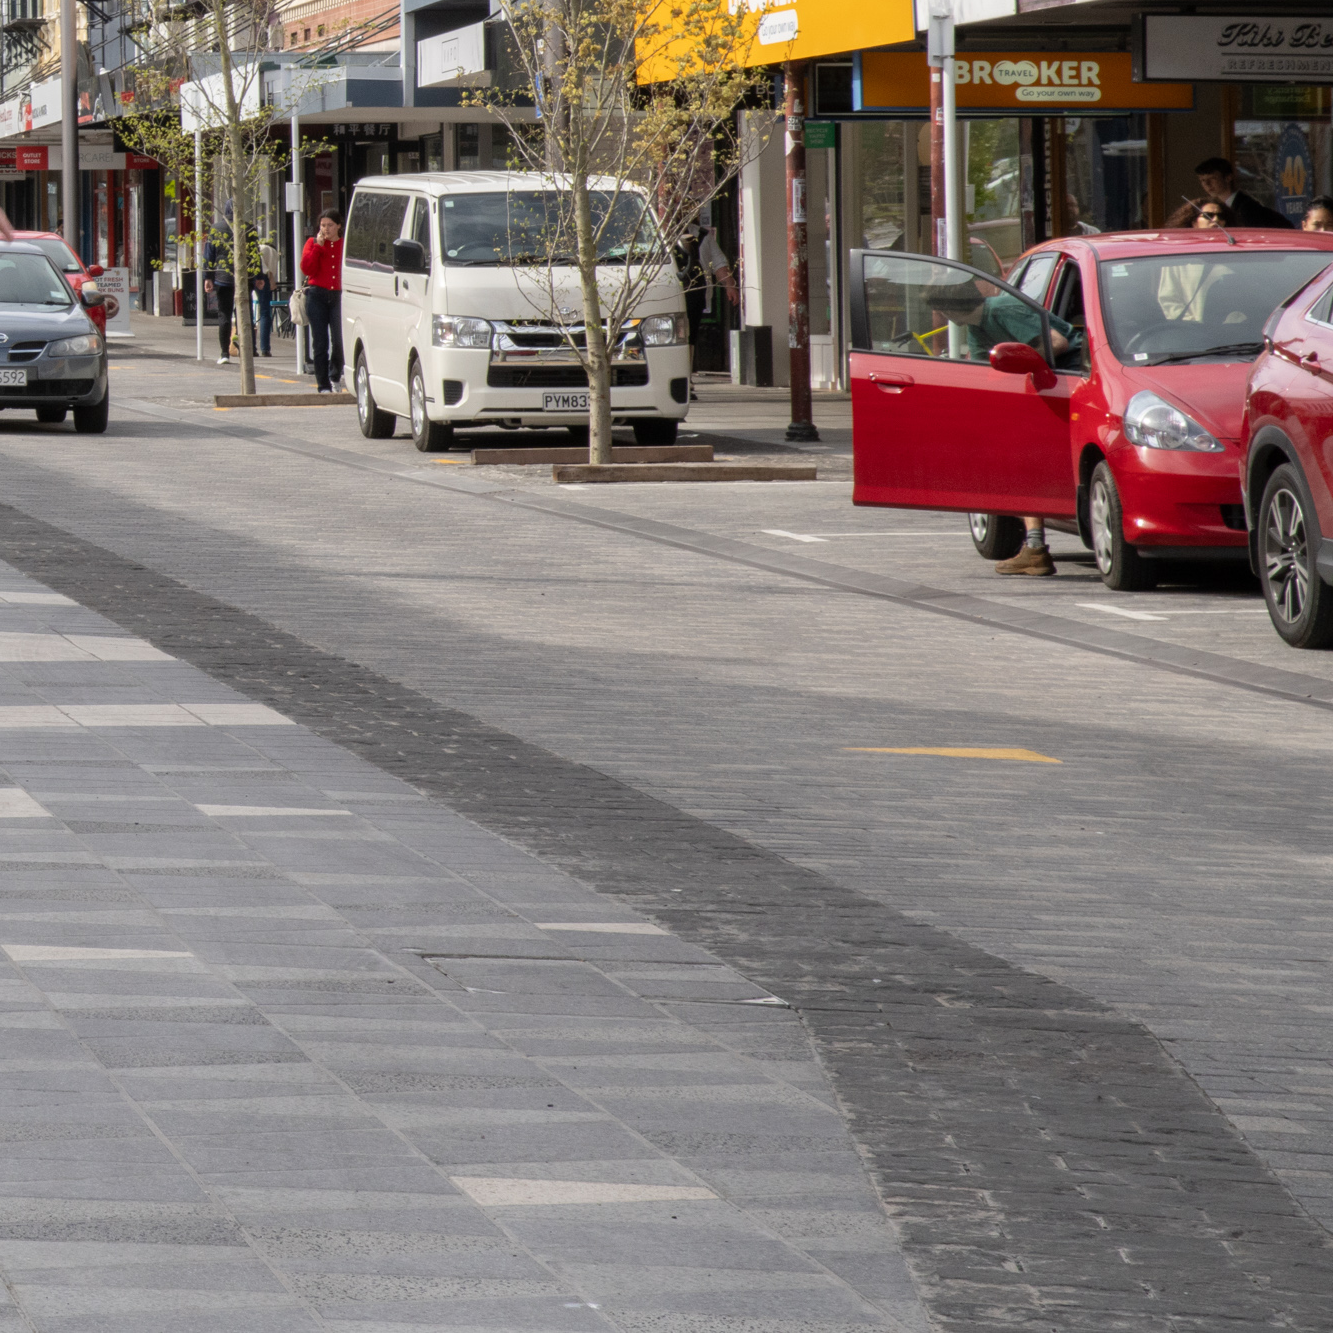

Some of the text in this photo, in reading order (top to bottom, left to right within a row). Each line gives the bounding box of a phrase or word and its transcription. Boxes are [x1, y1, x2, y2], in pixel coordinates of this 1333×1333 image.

[954, 60, 1101, 86] BROOKER
[998, 69, 1033, 77] TRAVEL
[1022, 89, 1034, 97] Go
[1036, 90, 1055, 99] your
[1078, 90, 1095, 99] way
[1280, 155, 1307, 195] 40
[1285, 201, 1304, 214] YEARS
[544, 395, 590, 408] PYM83
